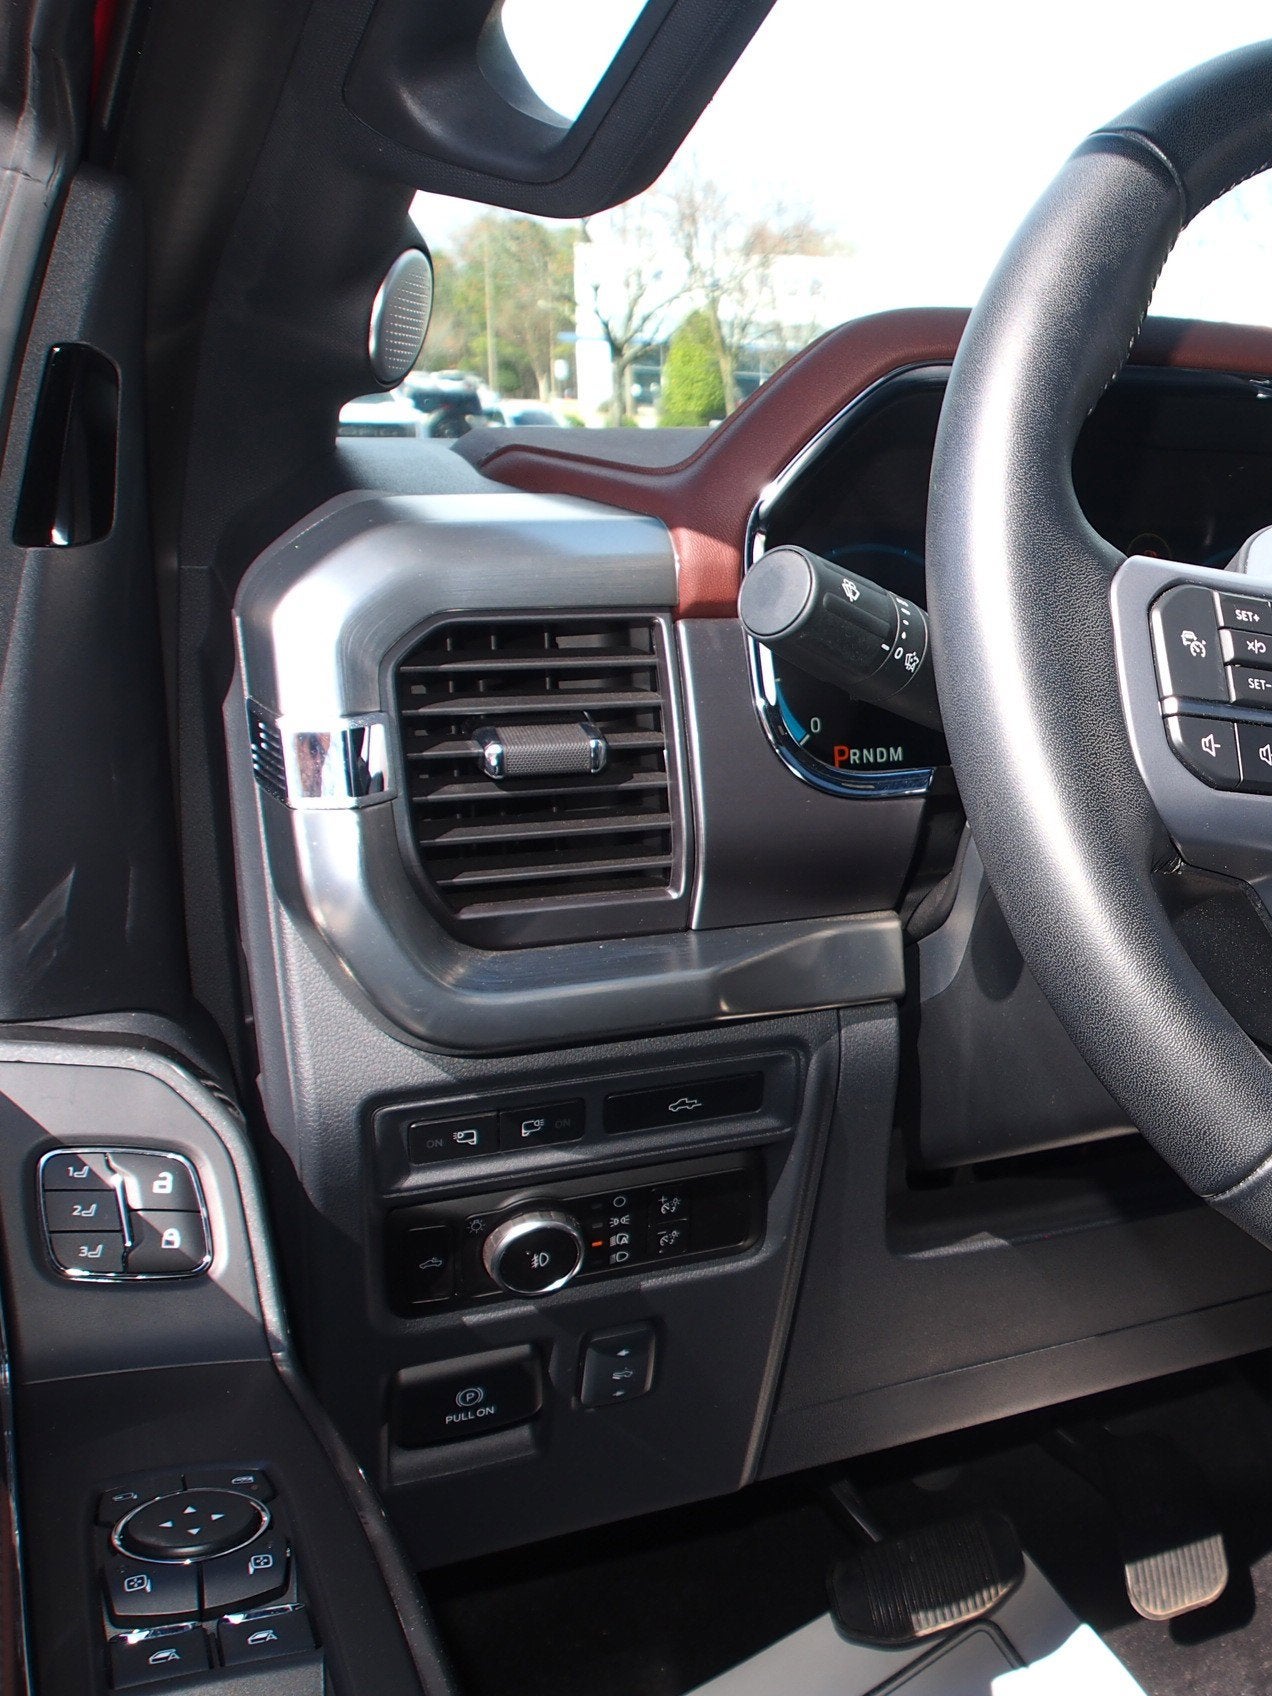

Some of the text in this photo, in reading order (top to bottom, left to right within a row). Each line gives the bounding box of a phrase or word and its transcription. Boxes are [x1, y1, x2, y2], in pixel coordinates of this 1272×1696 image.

[1235, 609, 1260, 623] SET+
[810, 716, 822, 734] 0
[426, 1138, 444, 1149] ON
[72, 1205, 81, 1216] 2
[78, 1246, 88, 1257] 3
[445, 1406, 495, 1424] PULL ON
